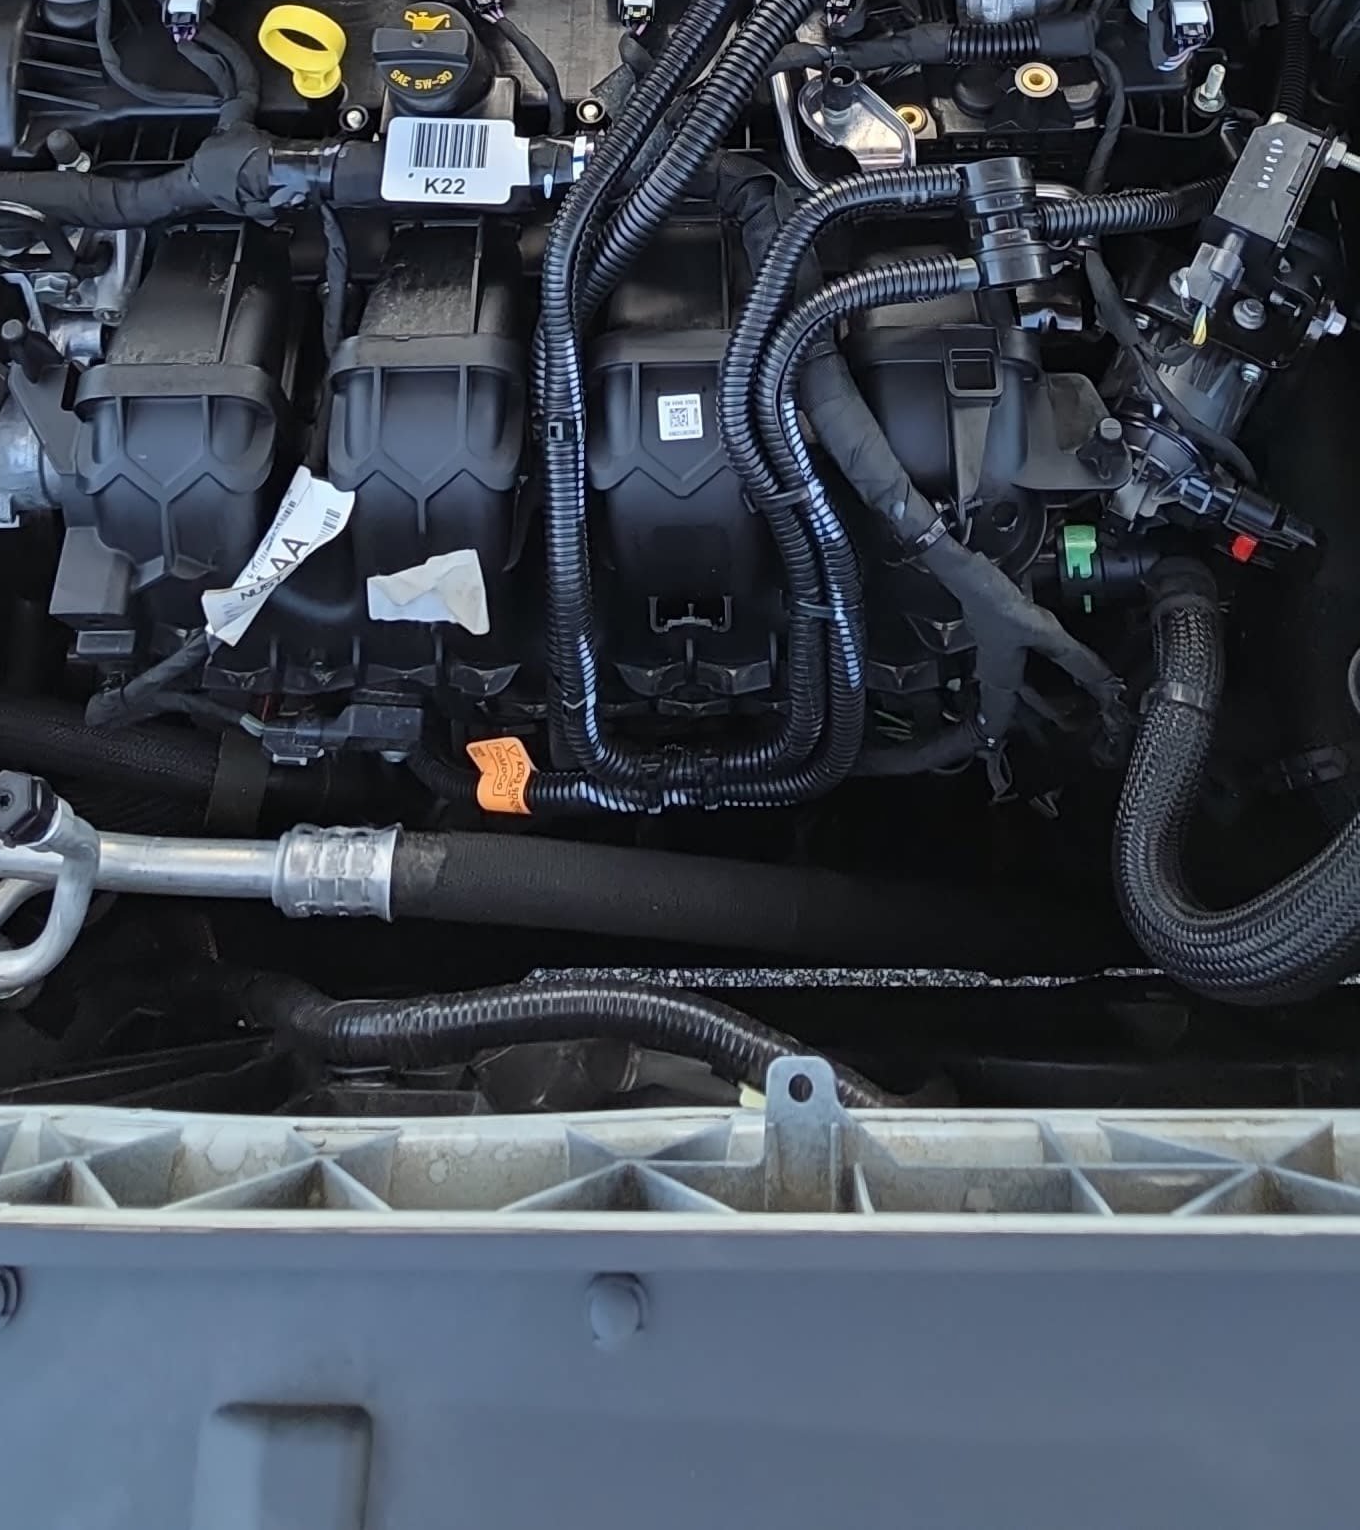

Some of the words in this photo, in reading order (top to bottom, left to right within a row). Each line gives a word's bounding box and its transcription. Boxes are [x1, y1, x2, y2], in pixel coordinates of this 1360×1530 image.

[389, 69, 412, 89] SAE
[415, 69, 454, 91] 5W-30
[423, 177, 466, 196] K22
